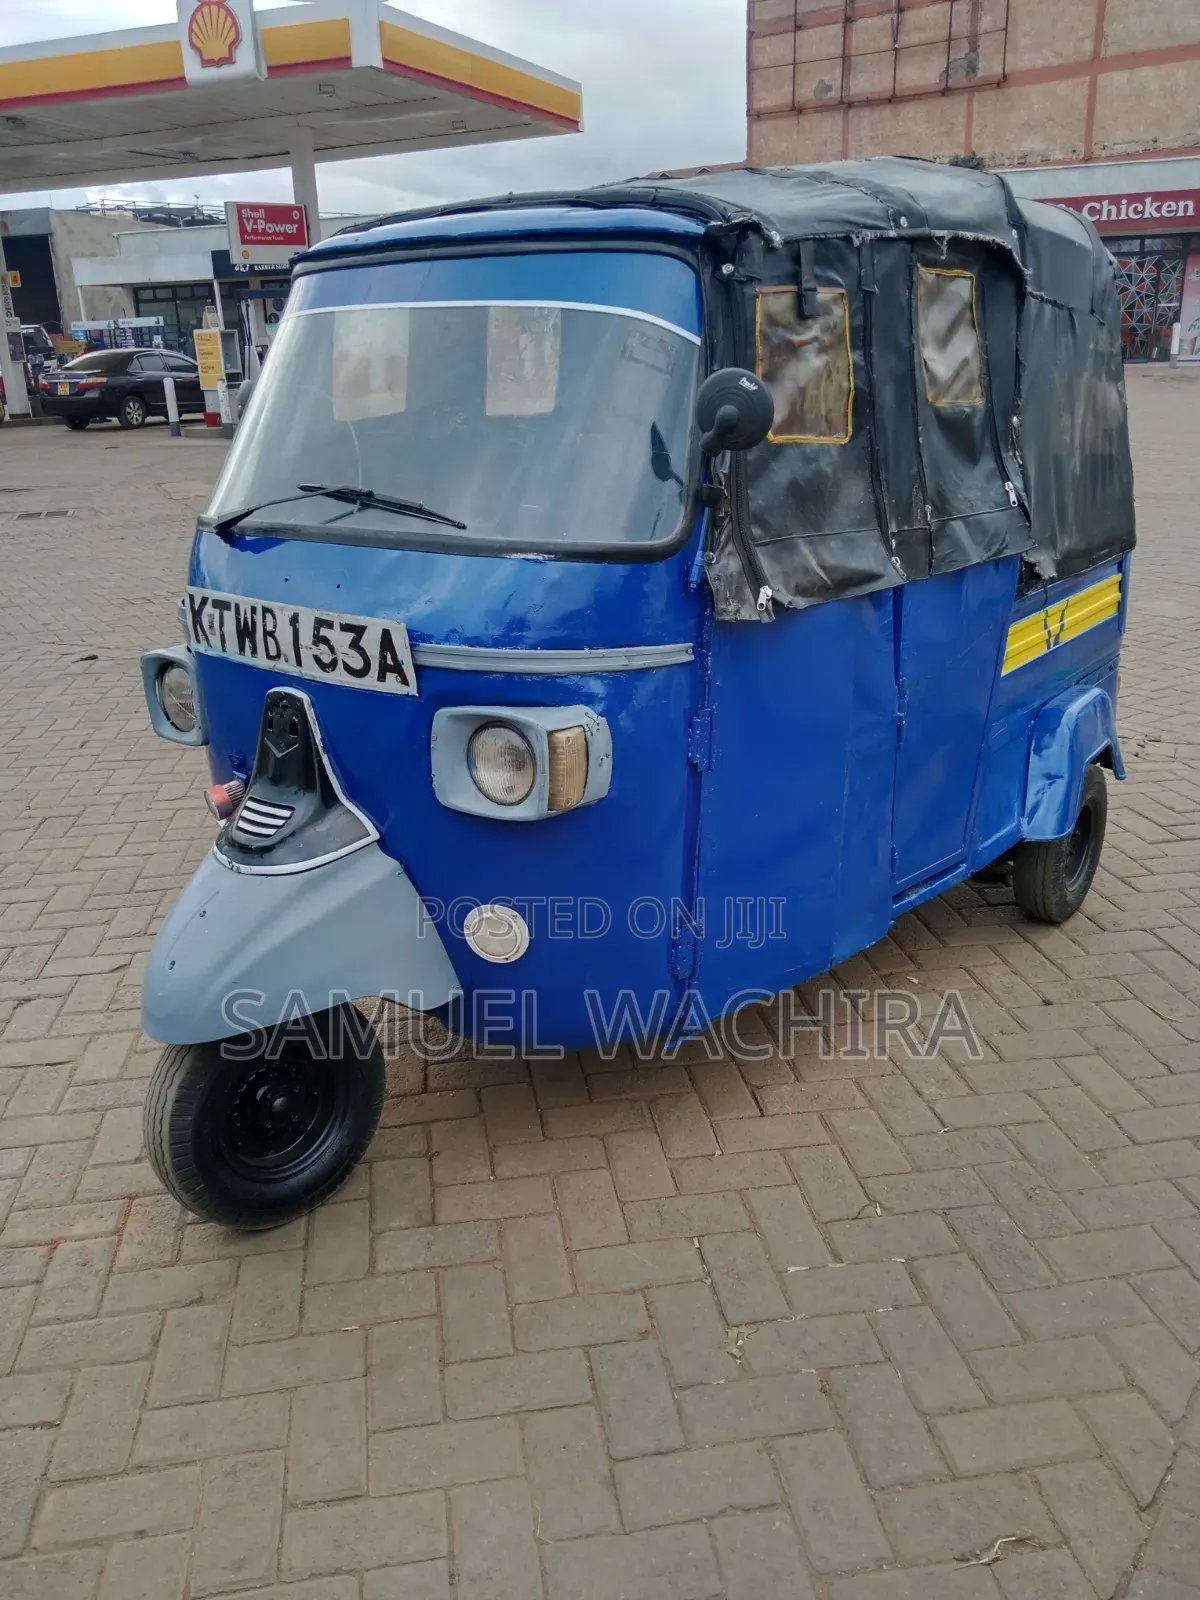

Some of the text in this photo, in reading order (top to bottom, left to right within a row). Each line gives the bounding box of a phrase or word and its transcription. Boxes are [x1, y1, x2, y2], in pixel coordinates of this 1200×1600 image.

[241, 208, 265, 218] Shell
[1082, 197, 1196, 222] Chicken
[243, 219, 299, 233] V-Power
